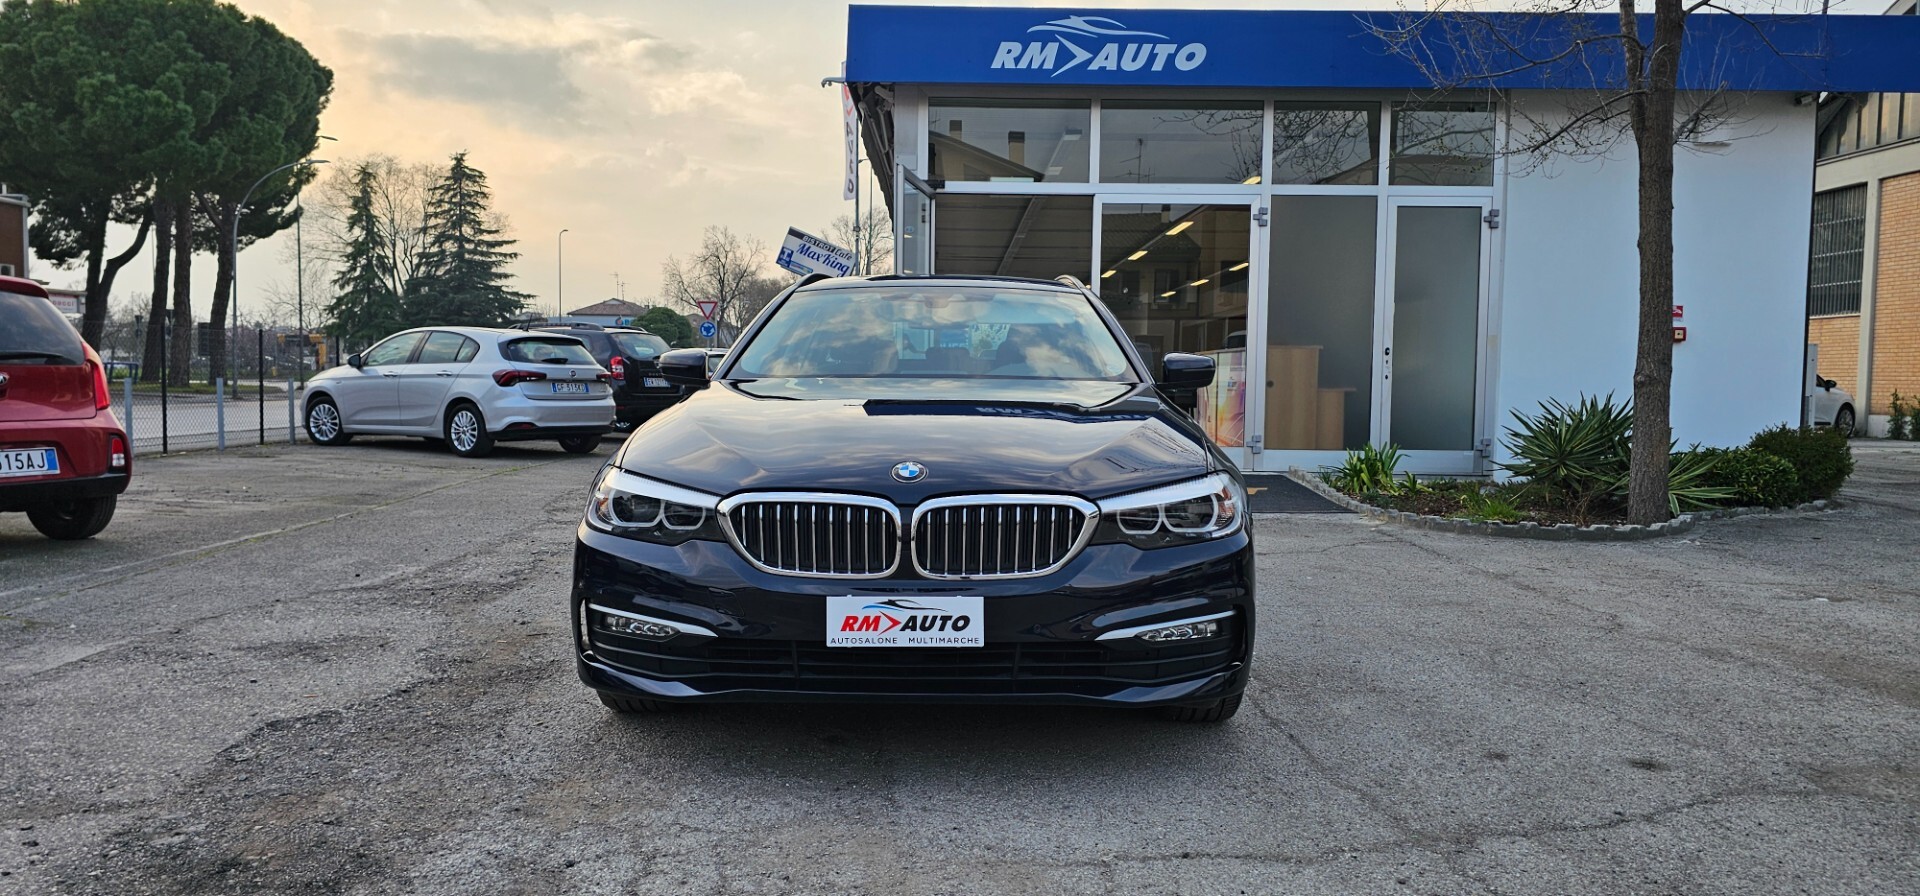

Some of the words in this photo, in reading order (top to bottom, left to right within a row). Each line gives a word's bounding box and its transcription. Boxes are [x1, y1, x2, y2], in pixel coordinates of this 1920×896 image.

[990, 41, 1060, 70] RM
[1086, 42, 1208, 72] AUTO
[802, 235, 836, 254] BISTROT
[0, 451, 47, 472] 15AJ
[840, 615, 882, 632] RM
[899, 615, 971, 632] AUTO
[830, 637, 898, 645] AUTOSALONE
[908, 637, 980, 645] MULTIMARCHE
